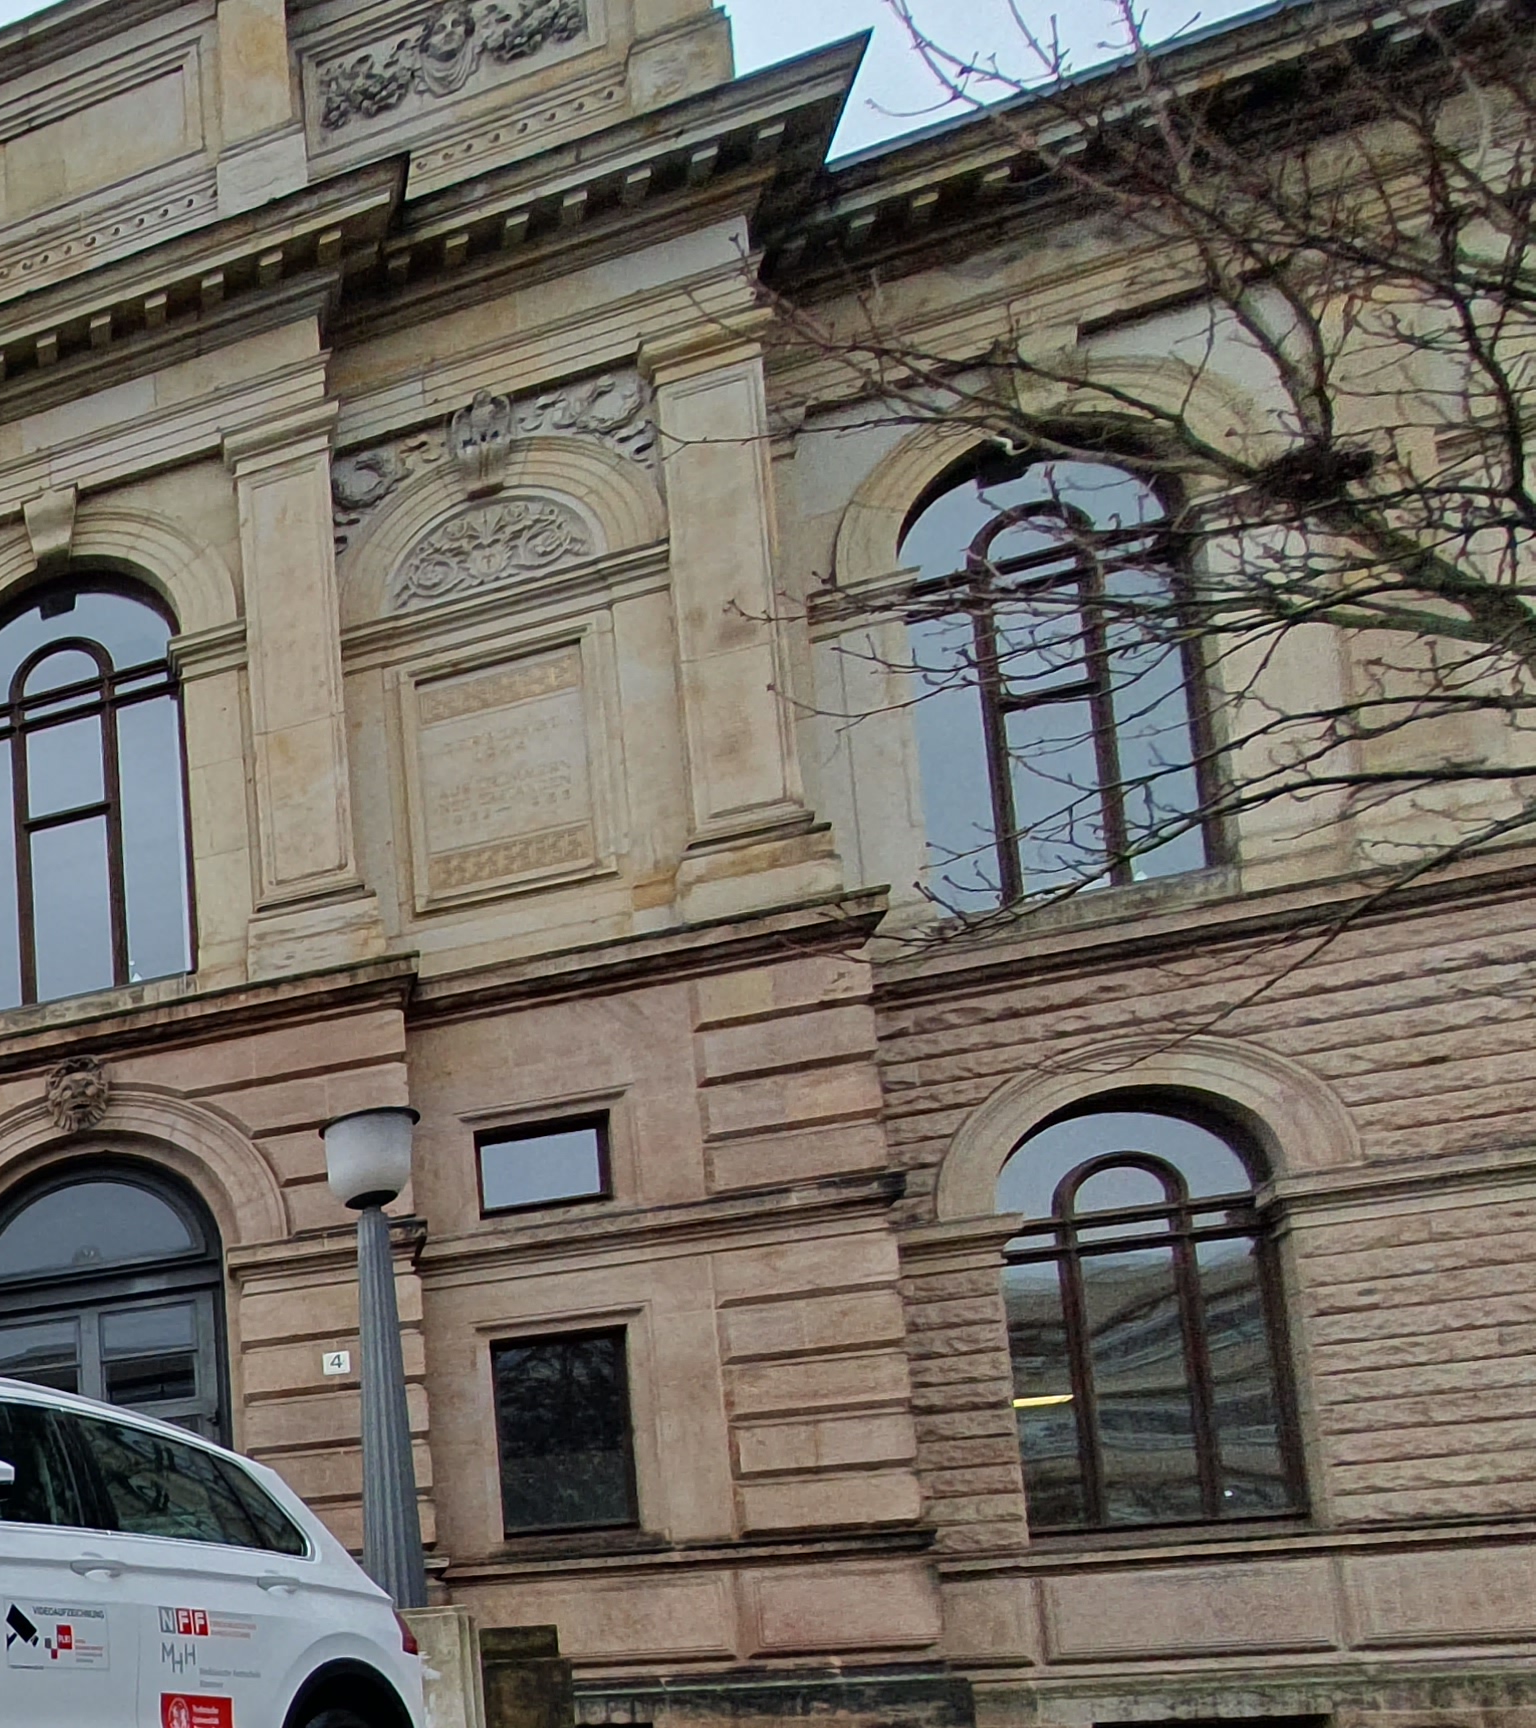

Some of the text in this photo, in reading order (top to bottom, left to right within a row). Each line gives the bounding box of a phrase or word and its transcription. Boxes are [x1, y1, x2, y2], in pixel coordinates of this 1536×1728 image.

[330, 1354, 343, 1369] 4
[159, 1607, 209, 1636] NFF
[161, 1642, 196, 1675] MHH
